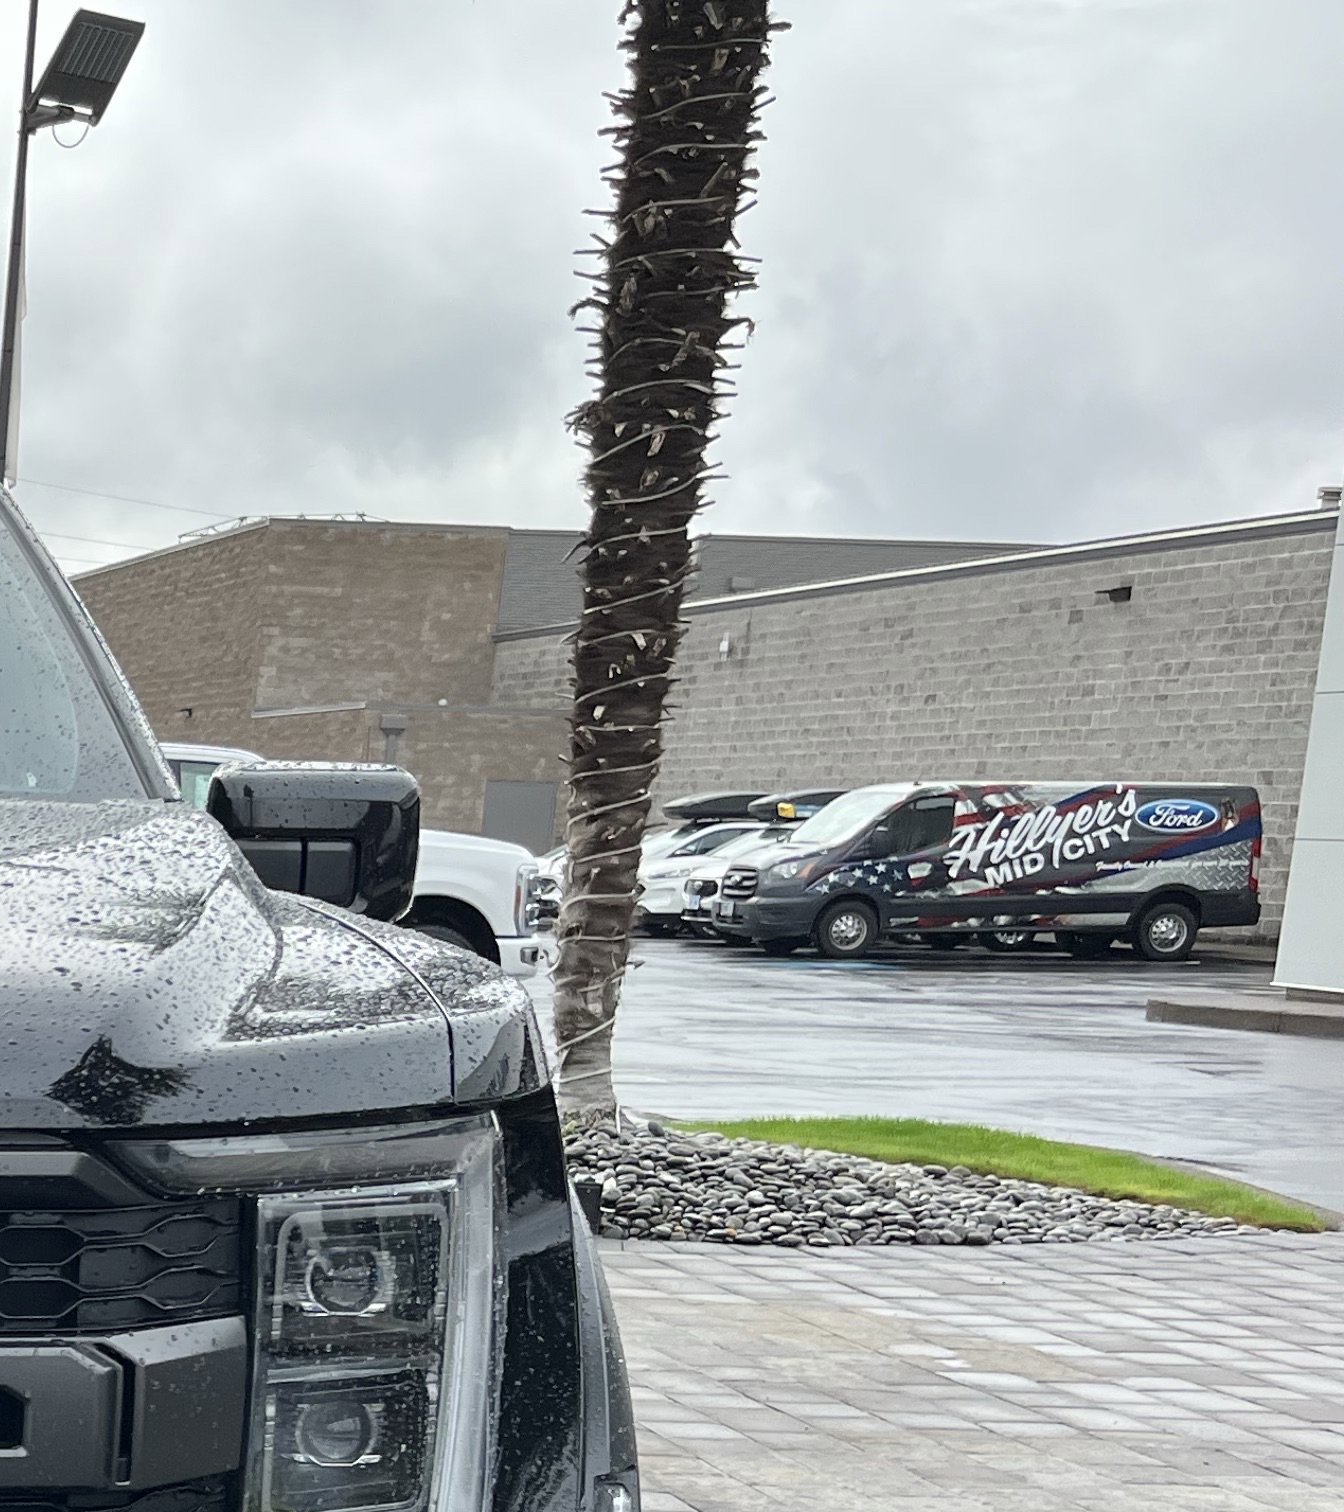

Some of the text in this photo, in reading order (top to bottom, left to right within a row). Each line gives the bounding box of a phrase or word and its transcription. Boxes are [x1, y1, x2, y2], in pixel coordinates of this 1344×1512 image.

[943, 784, 1137, 879] Hillyer's
[1149, 803, 1203, 827] Ford
[984, 819, 1132, 888] MID CITY
